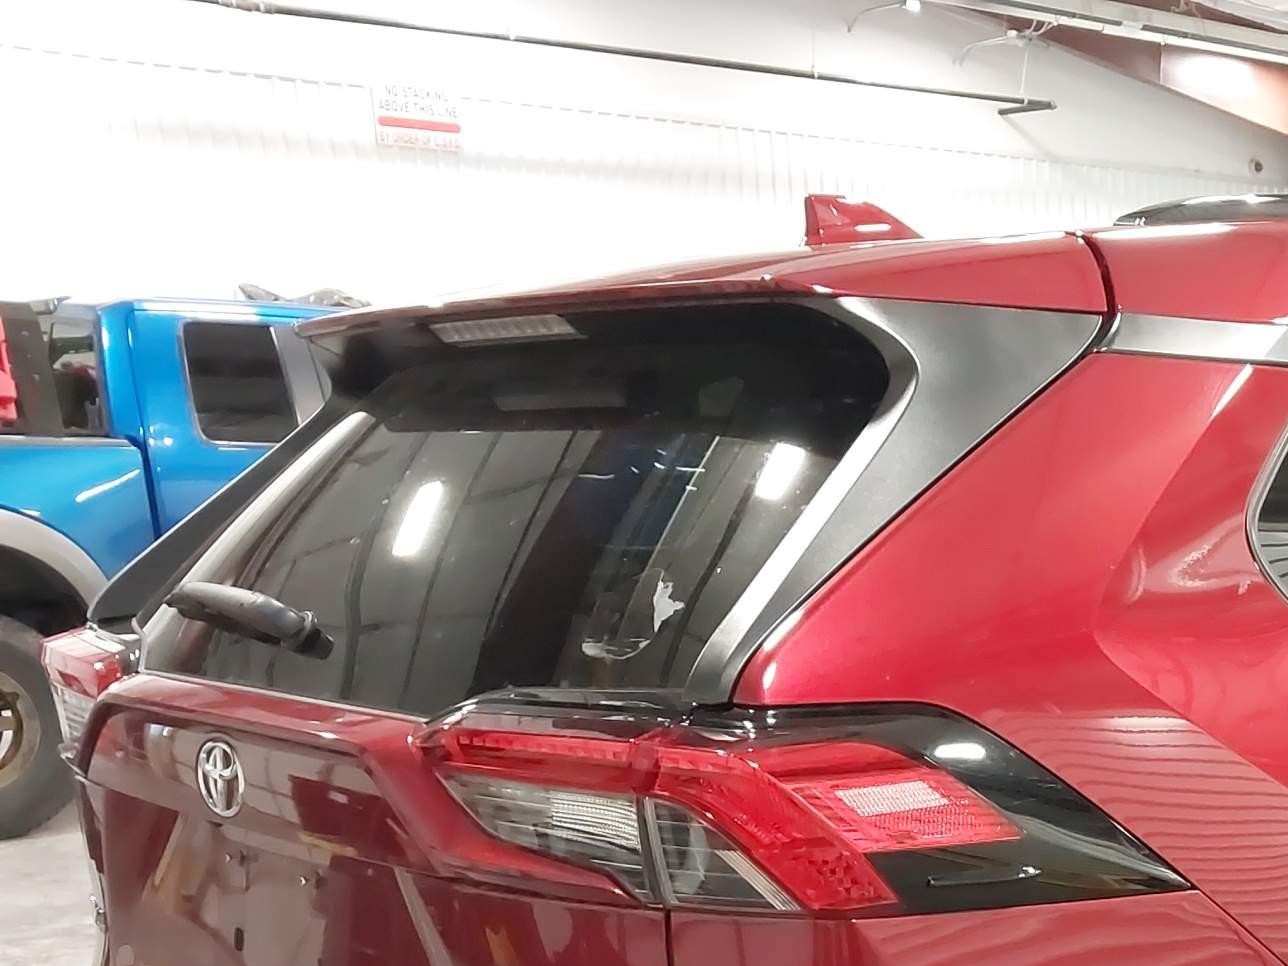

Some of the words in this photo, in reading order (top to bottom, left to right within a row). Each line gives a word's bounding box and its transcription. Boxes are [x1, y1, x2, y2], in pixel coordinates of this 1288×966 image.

[385, 84, 398, 98] NO
[379, 99, 409, 113] ABOVE
[413, 101, 435, 116] THIS
[438, 105, 458, 119] LNE
